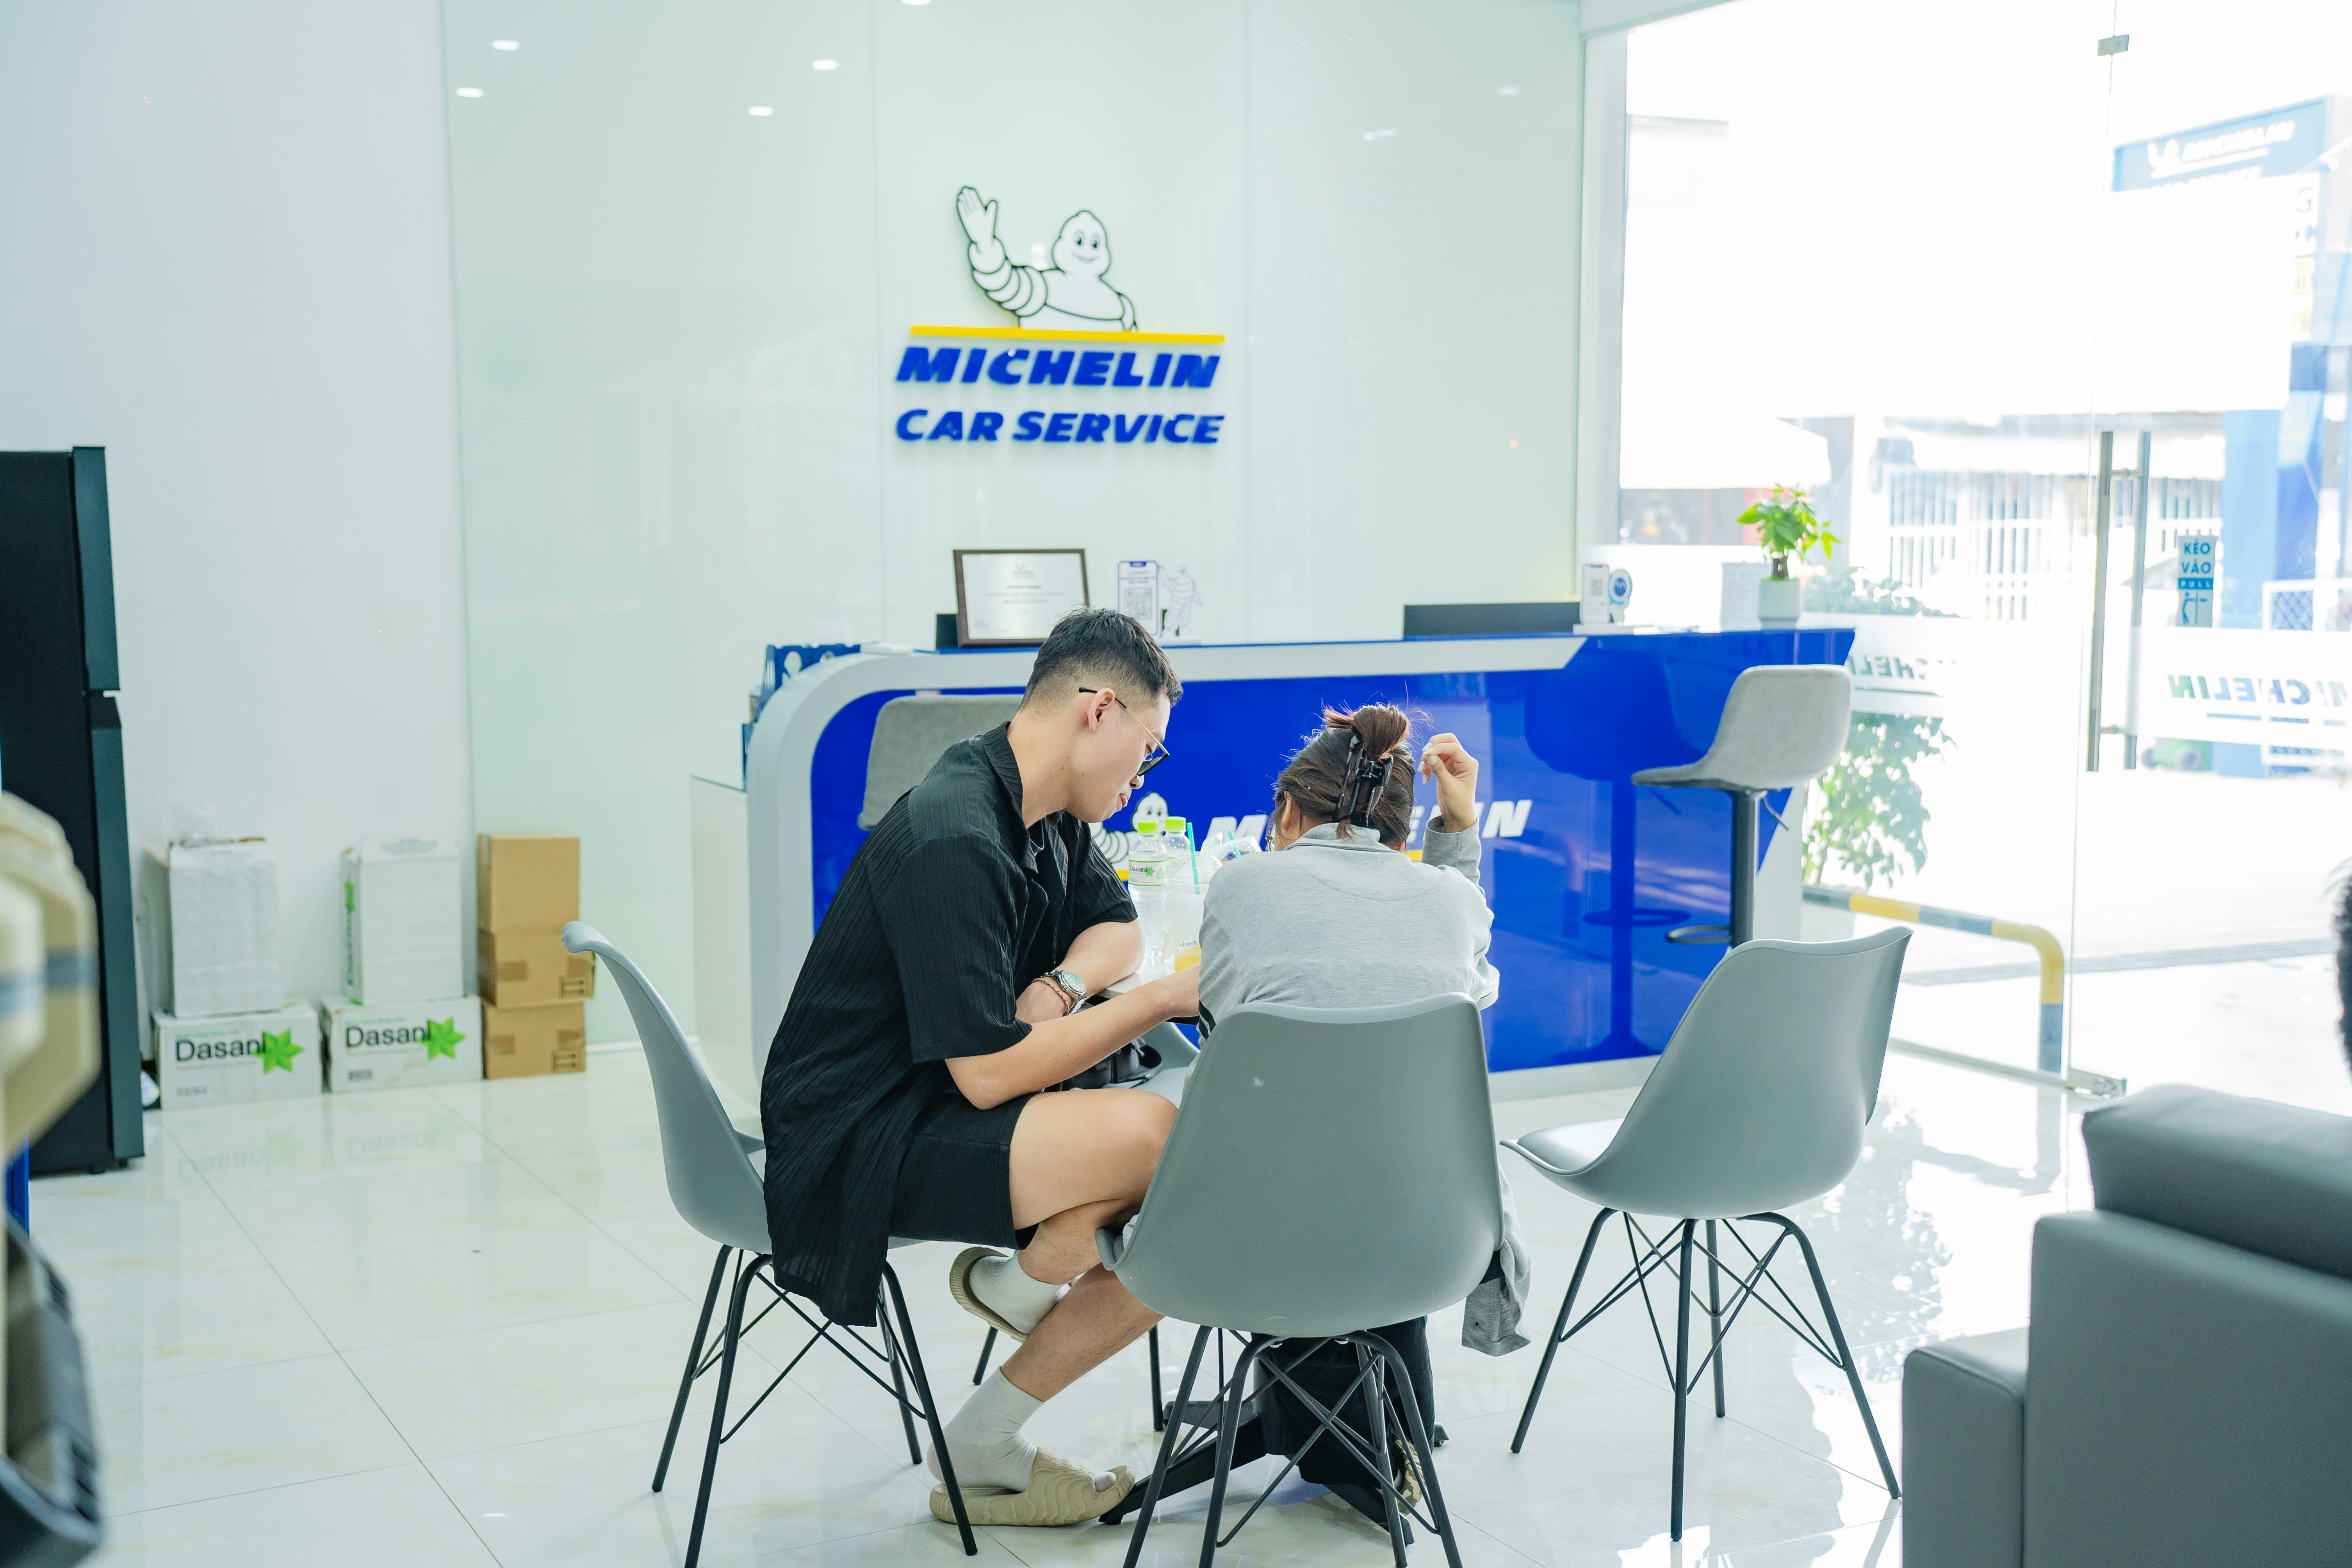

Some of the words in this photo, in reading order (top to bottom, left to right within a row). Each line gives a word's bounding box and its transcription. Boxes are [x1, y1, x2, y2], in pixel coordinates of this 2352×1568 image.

[896, 346, 1220, 388] MICHELIN
[896, 409, 1004, 441] CAR
[1012, 411, 1224, 444] SERVICE
[2184, 539, 2210, 554] KÉO
[2180, 580, 2210, 588] PULL
